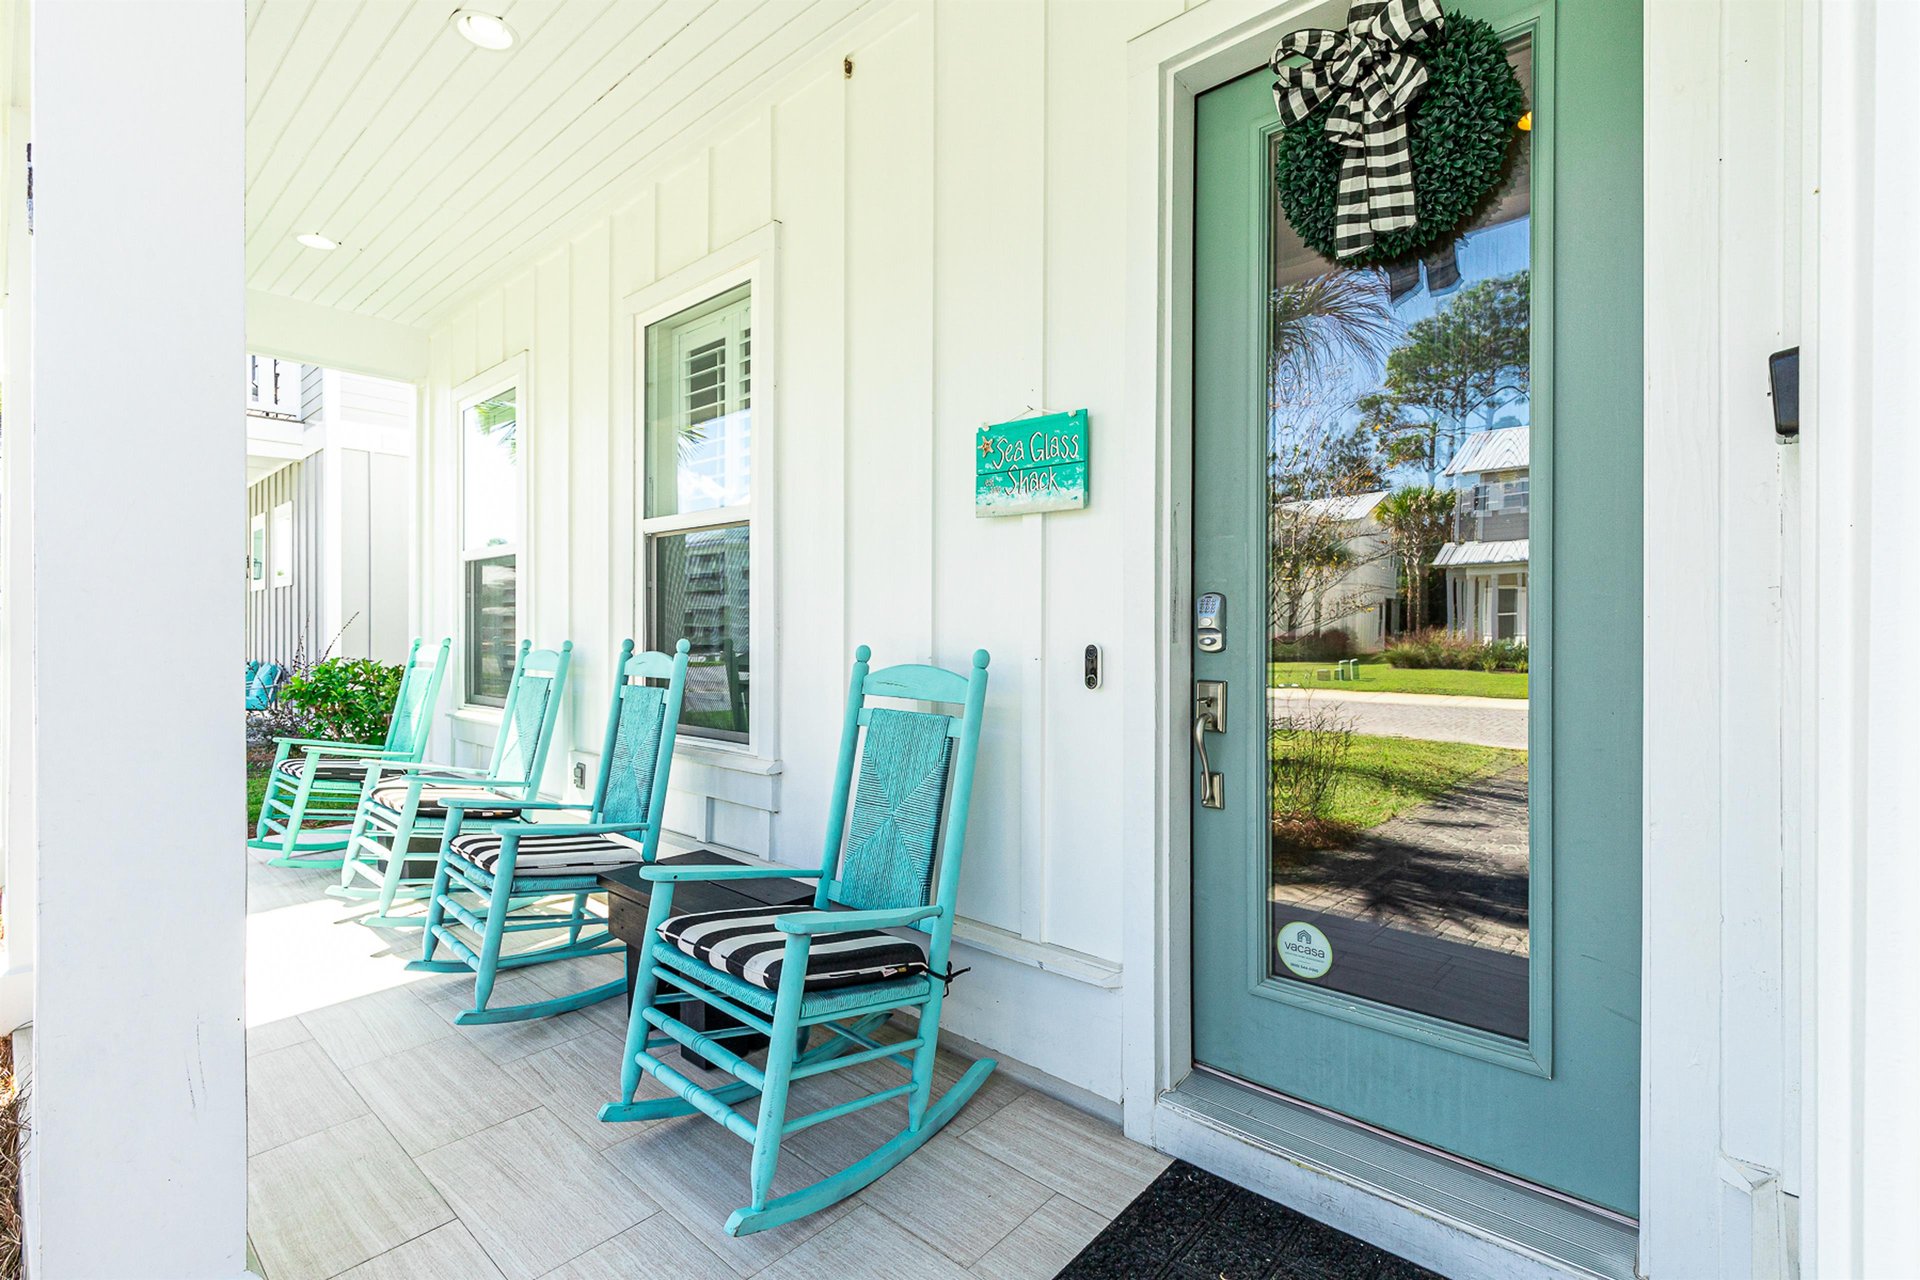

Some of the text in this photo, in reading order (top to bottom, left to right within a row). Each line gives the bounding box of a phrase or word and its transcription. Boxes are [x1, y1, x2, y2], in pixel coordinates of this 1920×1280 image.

[993, 431, 1079, 469] Sea Glass
[1004, 465, 1060, 496] Shack
[1284, 941, 1325, 959] vacasa
